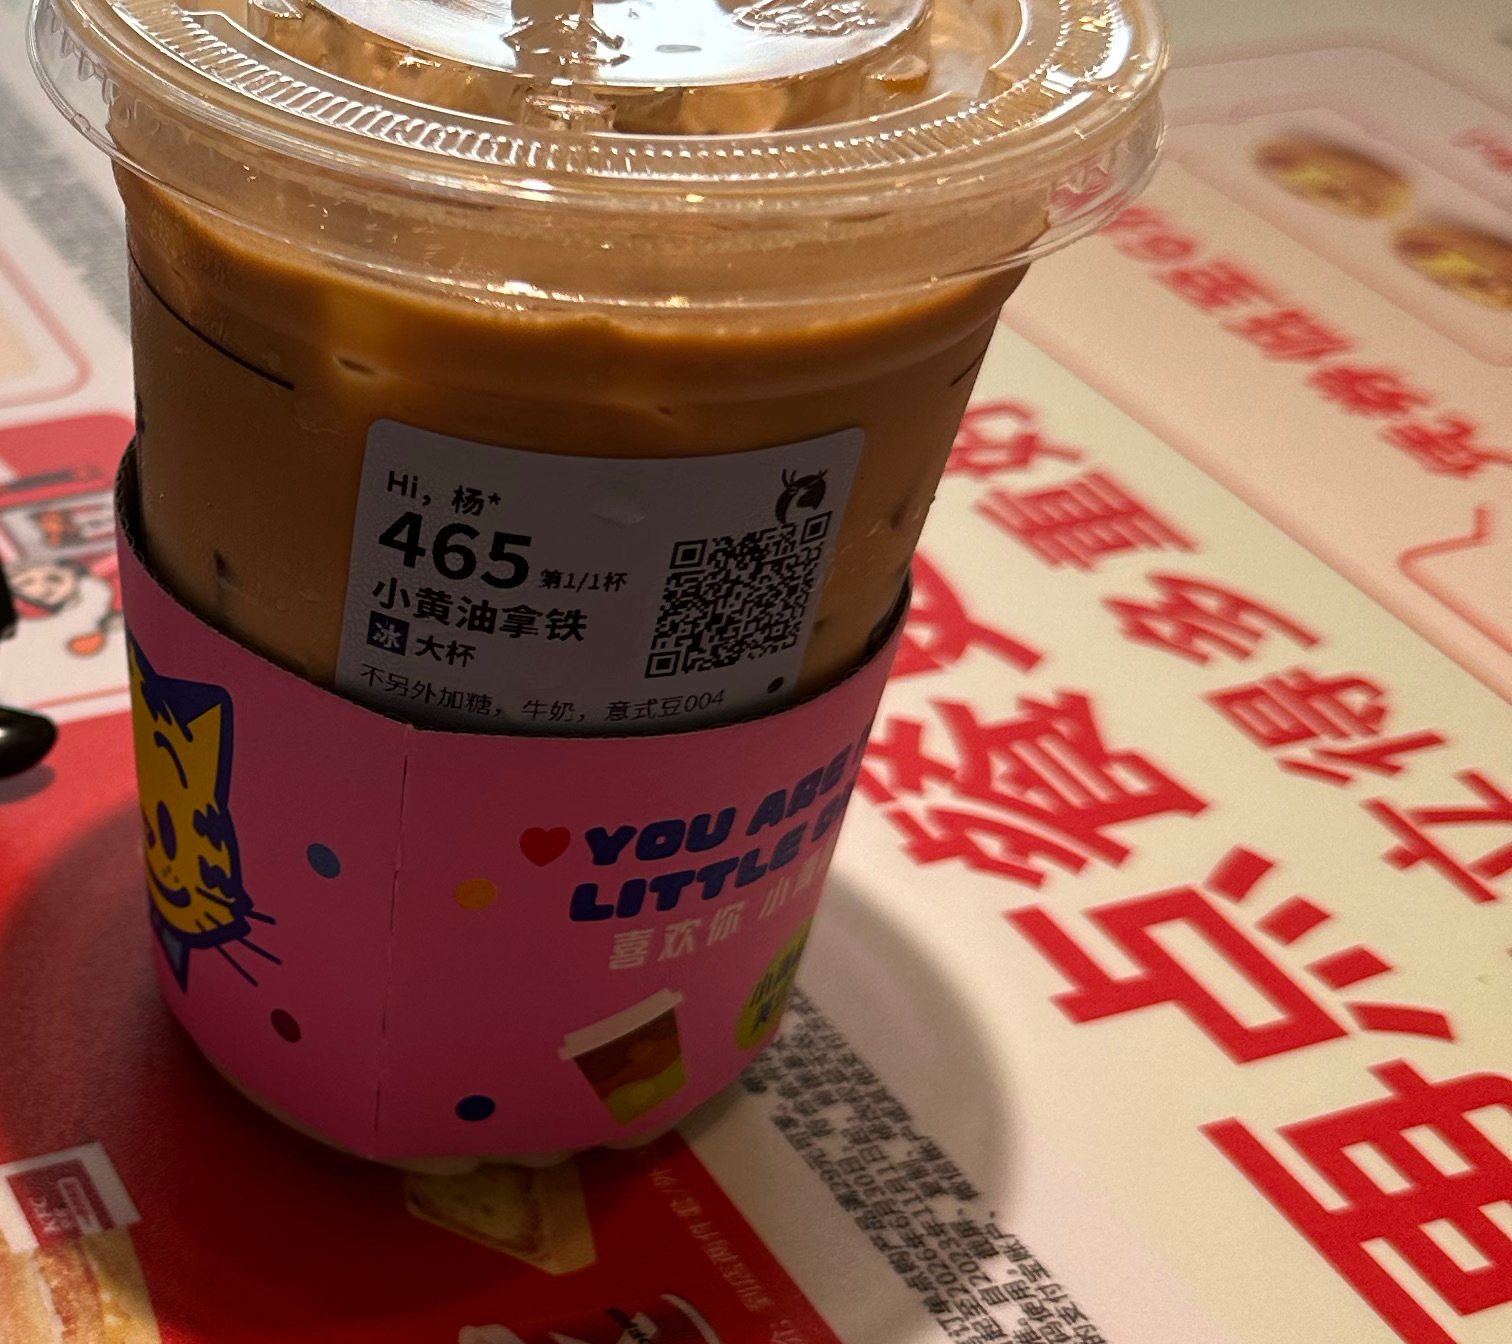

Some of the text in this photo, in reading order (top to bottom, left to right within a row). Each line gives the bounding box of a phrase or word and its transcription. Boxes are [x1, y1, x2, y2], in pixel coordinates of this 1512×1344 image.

[378, 511, 532, 590] 465
[539, 568, 628, 593] 第1/1杯
[372, 577, 588, 642] 小黄油拿铁
[415, 635, 477, 668] 大杯
[584, 806, 736, 867] YOU
[745, 742, 854, 837] ARE
[569, 822, 809, 923] LITTLE
[608, 899, 749, 971] 喜欢你
